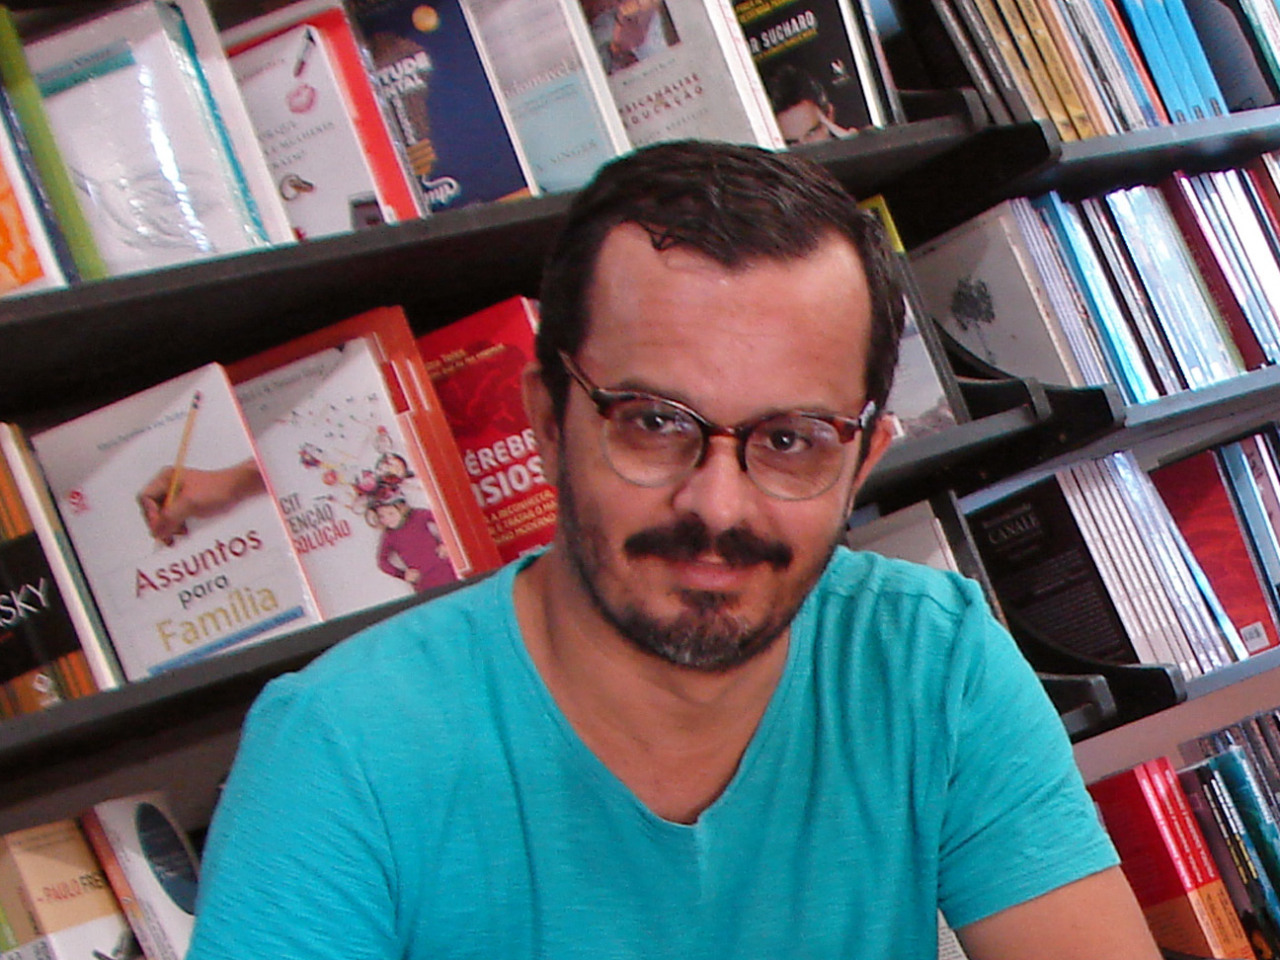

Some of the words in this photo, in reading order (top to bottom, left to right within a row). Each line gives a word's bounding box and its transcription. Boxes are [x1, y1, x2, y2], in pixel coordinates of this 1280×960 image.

[135, 529, 263, 599] Assuntos
[178, 573, 229, 609] para
[156, 586, 280, 652] Família
